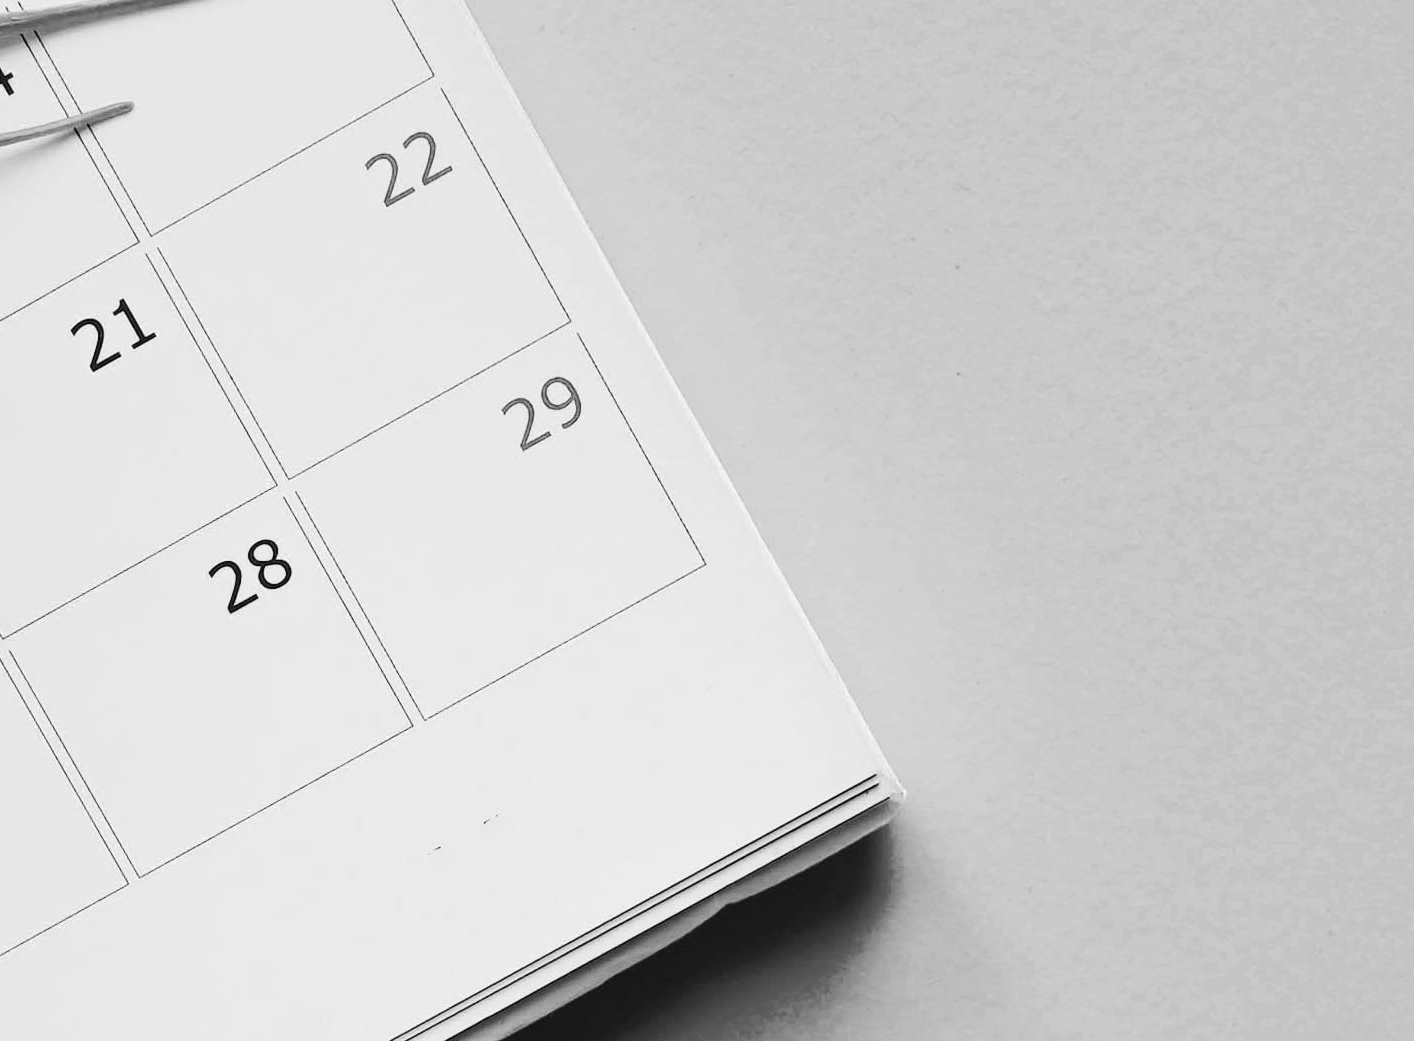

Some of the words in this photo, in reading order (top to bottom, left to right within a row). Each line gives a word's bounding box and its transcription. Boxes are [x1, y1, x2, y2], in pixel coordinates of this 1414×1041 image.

[364, 131, 454, 208] 22
[70, 298, 158, 373] 21
[501, 376, 583, 452] 29
[207, 538, 293, 615] 28
